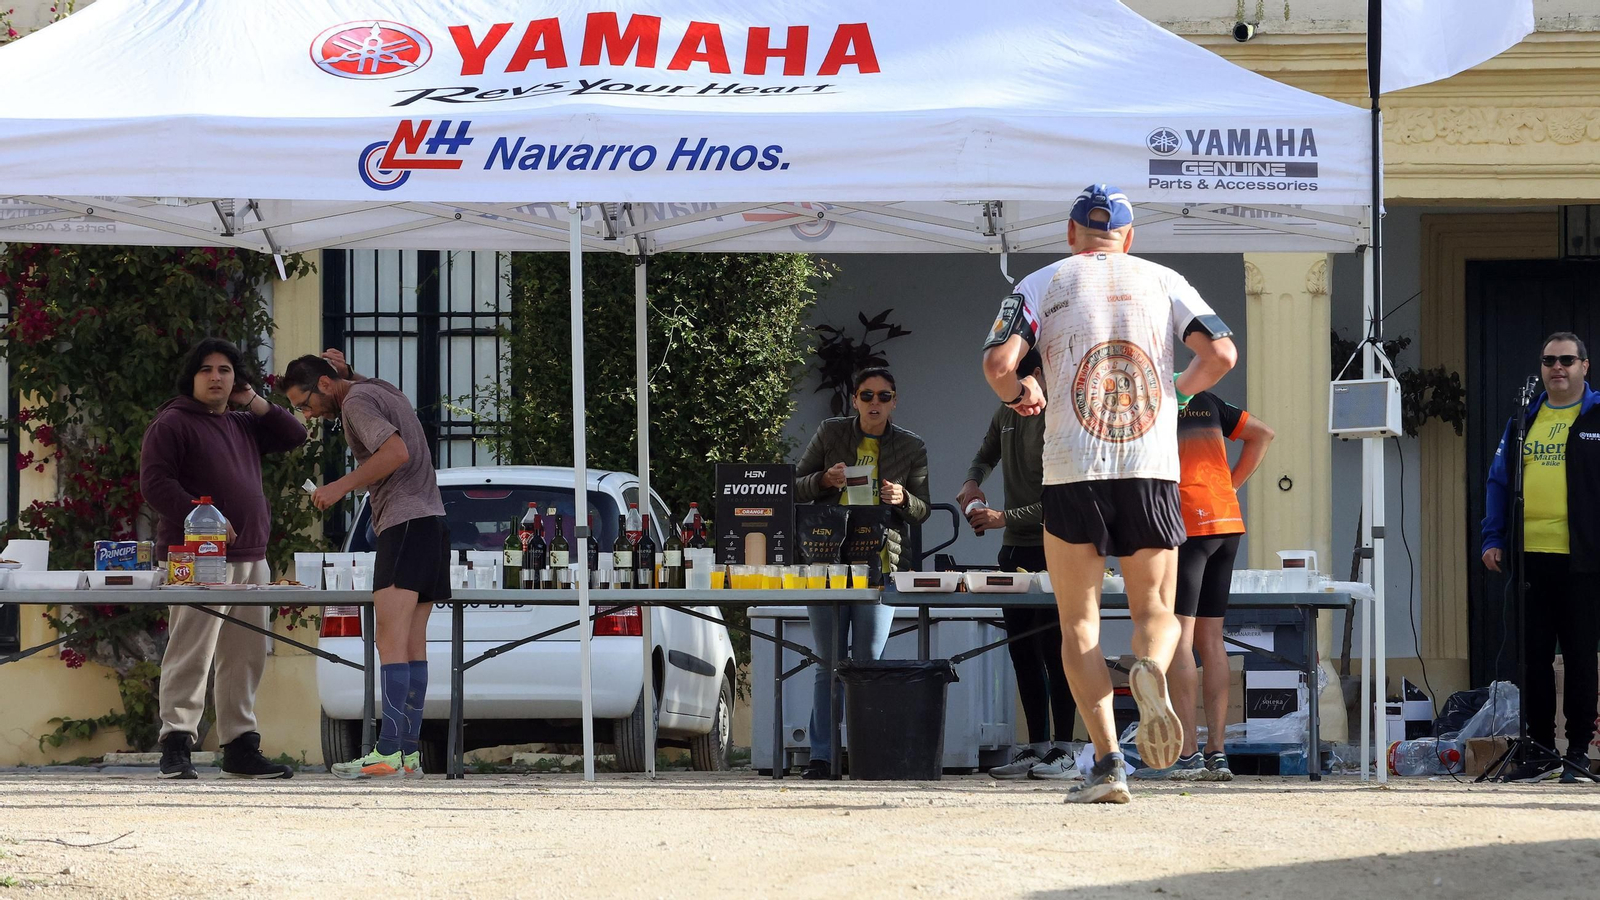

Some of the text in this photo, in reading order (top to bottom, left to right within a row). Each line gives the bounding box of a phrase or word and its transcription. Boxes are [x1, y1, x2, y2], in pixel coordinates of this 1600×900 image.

[448, 11, 880, 77] YAMAHA
[390, 78, 836, 107] Revs Your Heart
[1185, 128, 1318, 157] YAMAHA
[483, 136, 658, 171] Navarro
[666, 137, 790, 171] Hnos.
[1181, 161, 1286, 177] GENUINE
[1148, 178, 1318, 191] Parts & Accessories
[1522, 441, 1566, 455] Sher
[723, 484, 788, 495] EVOTONIC
[99, 545, 137, 561] PRINCIPE
[174, 567, 190, 577] Krit
